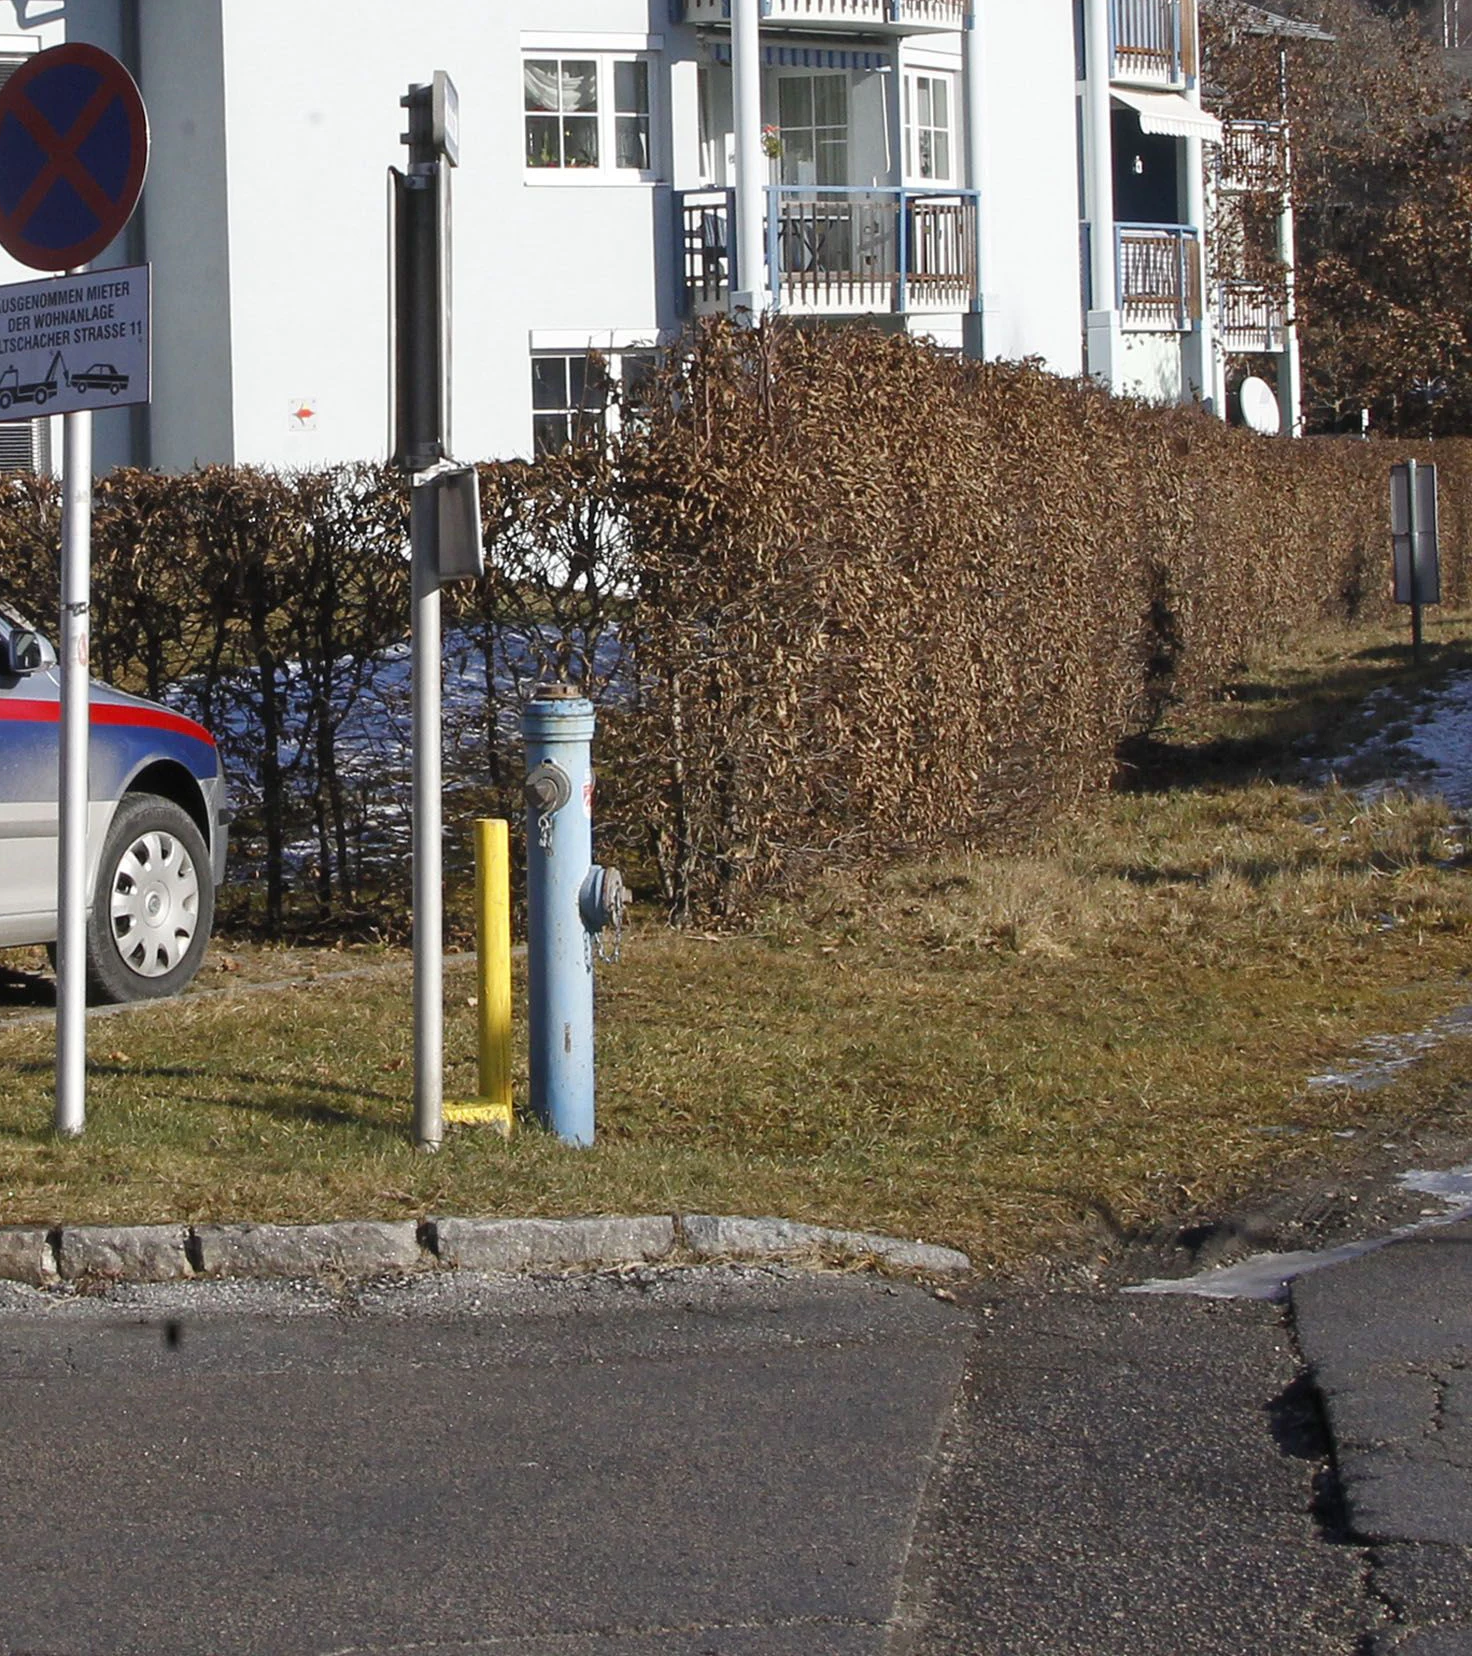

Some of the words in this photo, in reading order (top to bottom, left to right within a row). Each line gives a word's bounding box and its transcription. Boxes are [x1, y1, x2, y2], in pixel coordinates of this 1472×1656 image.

[86, 281, 130, 300] MIETER
[8, 316, 30, 333] DER
[34, 303, 115, 329] WOHNANLAGE
[73, 322, 126, 342] STRASSE
[130, 320, 143, 336] 11
